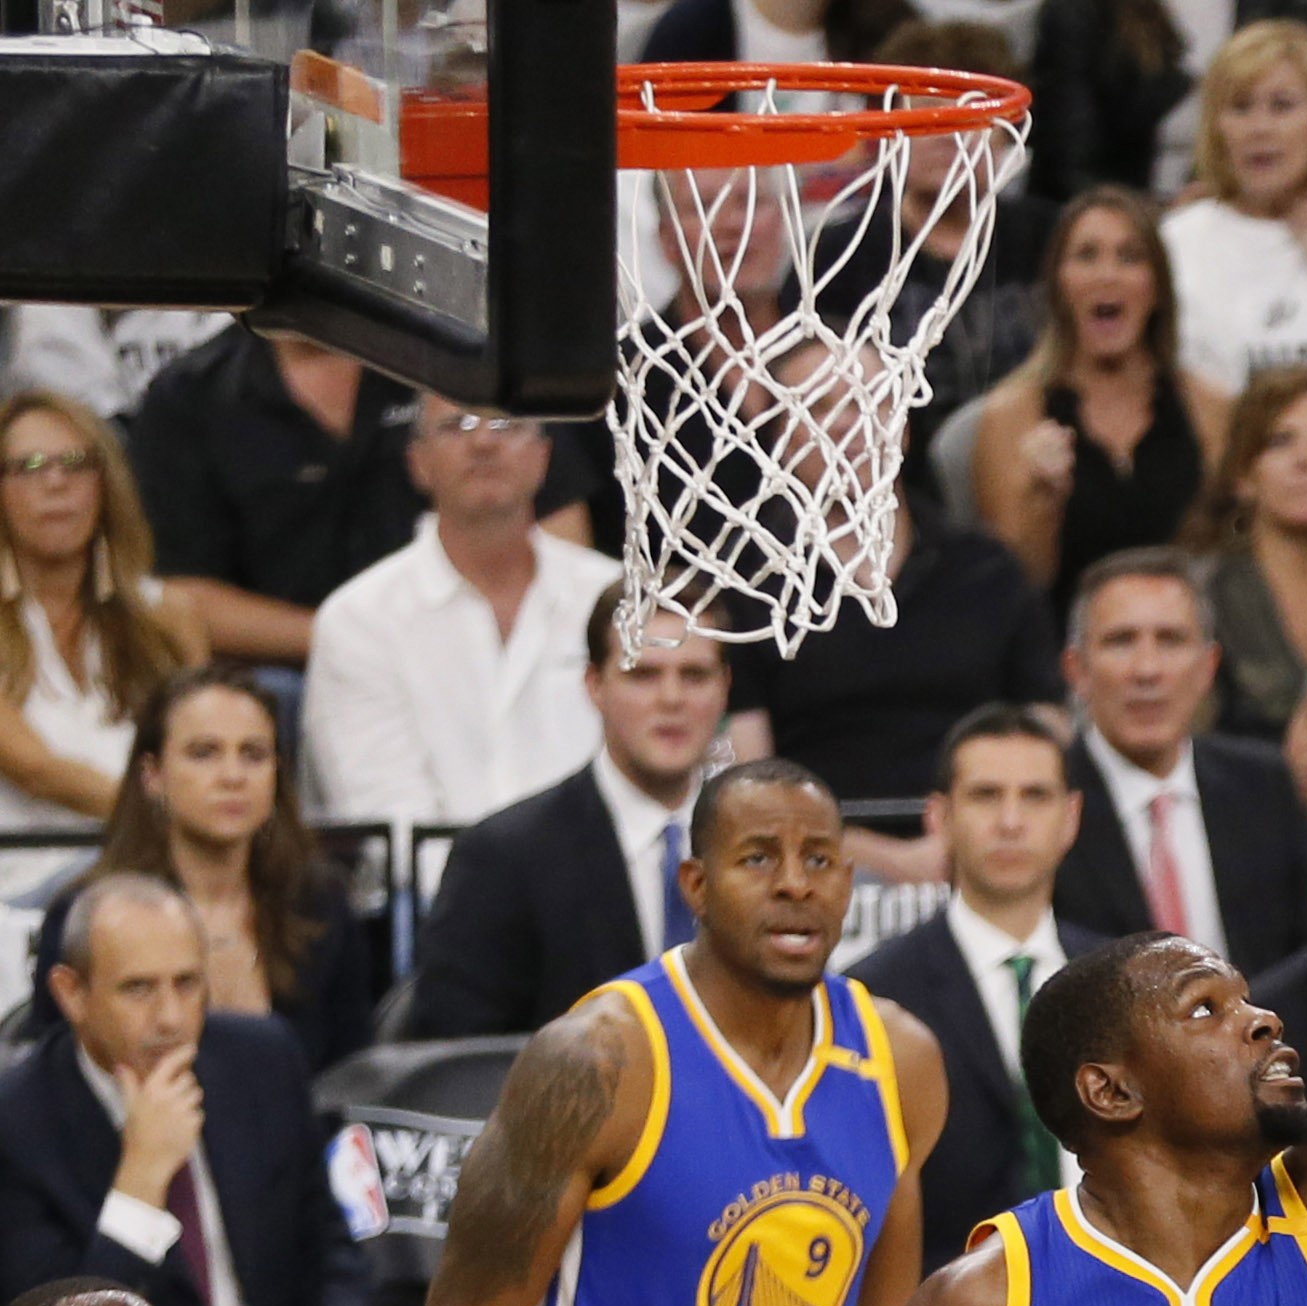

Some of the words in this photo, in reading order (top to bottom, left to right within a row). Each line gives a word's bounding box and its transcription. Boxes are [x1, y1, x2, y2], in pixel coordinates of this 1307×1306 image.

[707, 1171, 801, 1242] GOLDEN
[807, 1174, 871, 1229] STATE
[804, 1237, 833, 1279] 9
